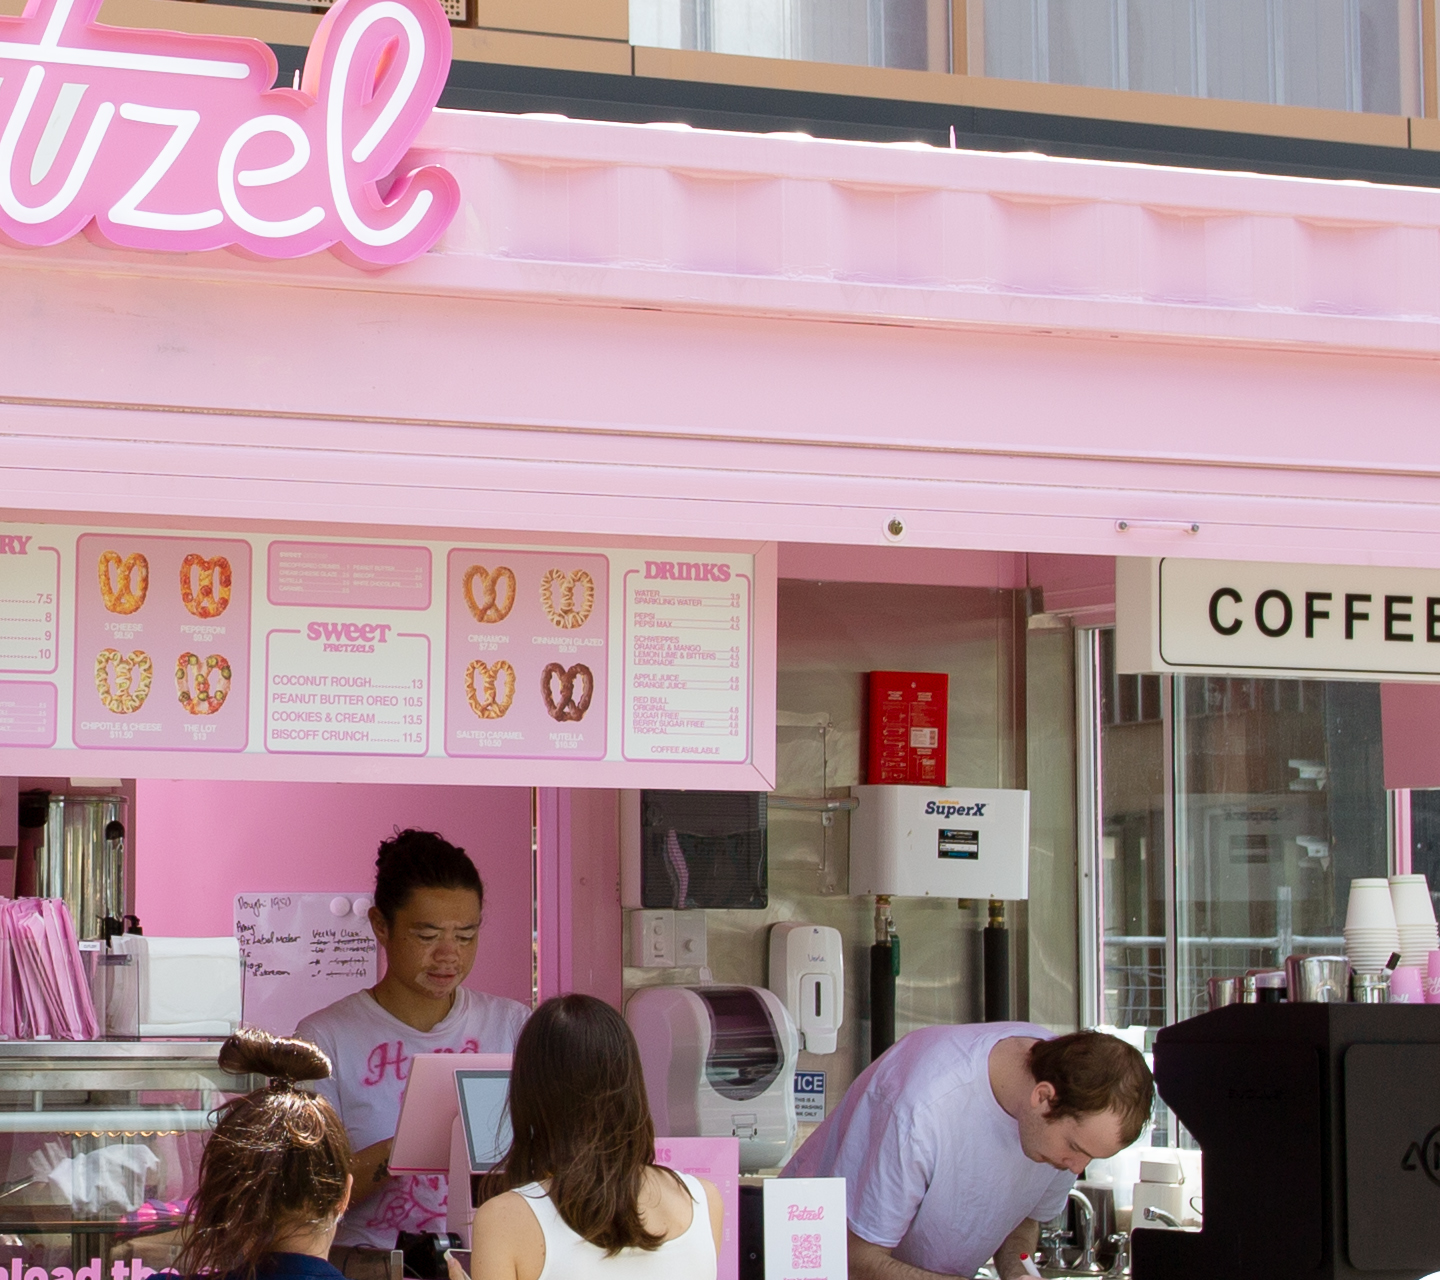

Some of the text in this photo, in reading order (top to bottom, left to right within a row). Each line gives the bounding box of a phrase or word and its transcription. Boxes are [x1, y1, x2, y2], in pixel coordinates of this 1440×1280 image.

[37, 593, 52, 605] 7.5
[634, 597, 676, 605] SPARKLING
[45, 612, 52, 622] 8
[105, 623, 143, 632] 3 CHEESE
[634, 620, 655, 628] PEPSI
[180, 626, 226, 635] PEPPERONI
[45, 630, 51, 641] 9
[468, 634, 509, 644] CINNAMON
[634, 636, 680, 644] SCHWEPPES
[532, 636, 604, 646] CINNAMON GLAZED
[674, 644, 701, 652] MANGO
[39, 648, 51, 660] 10
[634, 651, 660, 659] LEMON
[273, 674, 423, 689] COCONUT ROUGH 13
[659, 674, 680, 682] JUICE
[634, 681, 665, 689] ORANGE
[666, 682, 687, 690] JUICE
[273, 693, 423, 707] PEANUT BUTTER OREO 10.5
[650, 697, 669, 705] BULL
[633, 704, 668, 712] ORIGINAL
[272, 711, 423, 725] COOKIES & CREAM 13.5
[633, 712, 659, 720] SUGAR
[81, 721, 121, 731] CHIPOTLE
[129, 723, 162, 732] CHEESE
[633, 719, 658, 727] BERRY
[659, 720, 685, 728] SUGAR
[184, 724, 217, 733] THE LOT
[633, 727, 668, 735] TROPICAL
[272, 729, 422, 743] BISCOFF CRUNCH 11.5
[456, 730, 524, 740] SALTED CARAMEL
[549, 732, 584, 741] NUTELLA
[651, 746, 720, 755] COFFEE AVAILABLE
[925, 801, 986, 819] SuperX
[787, 1204, 824, 1221] Pretzel
